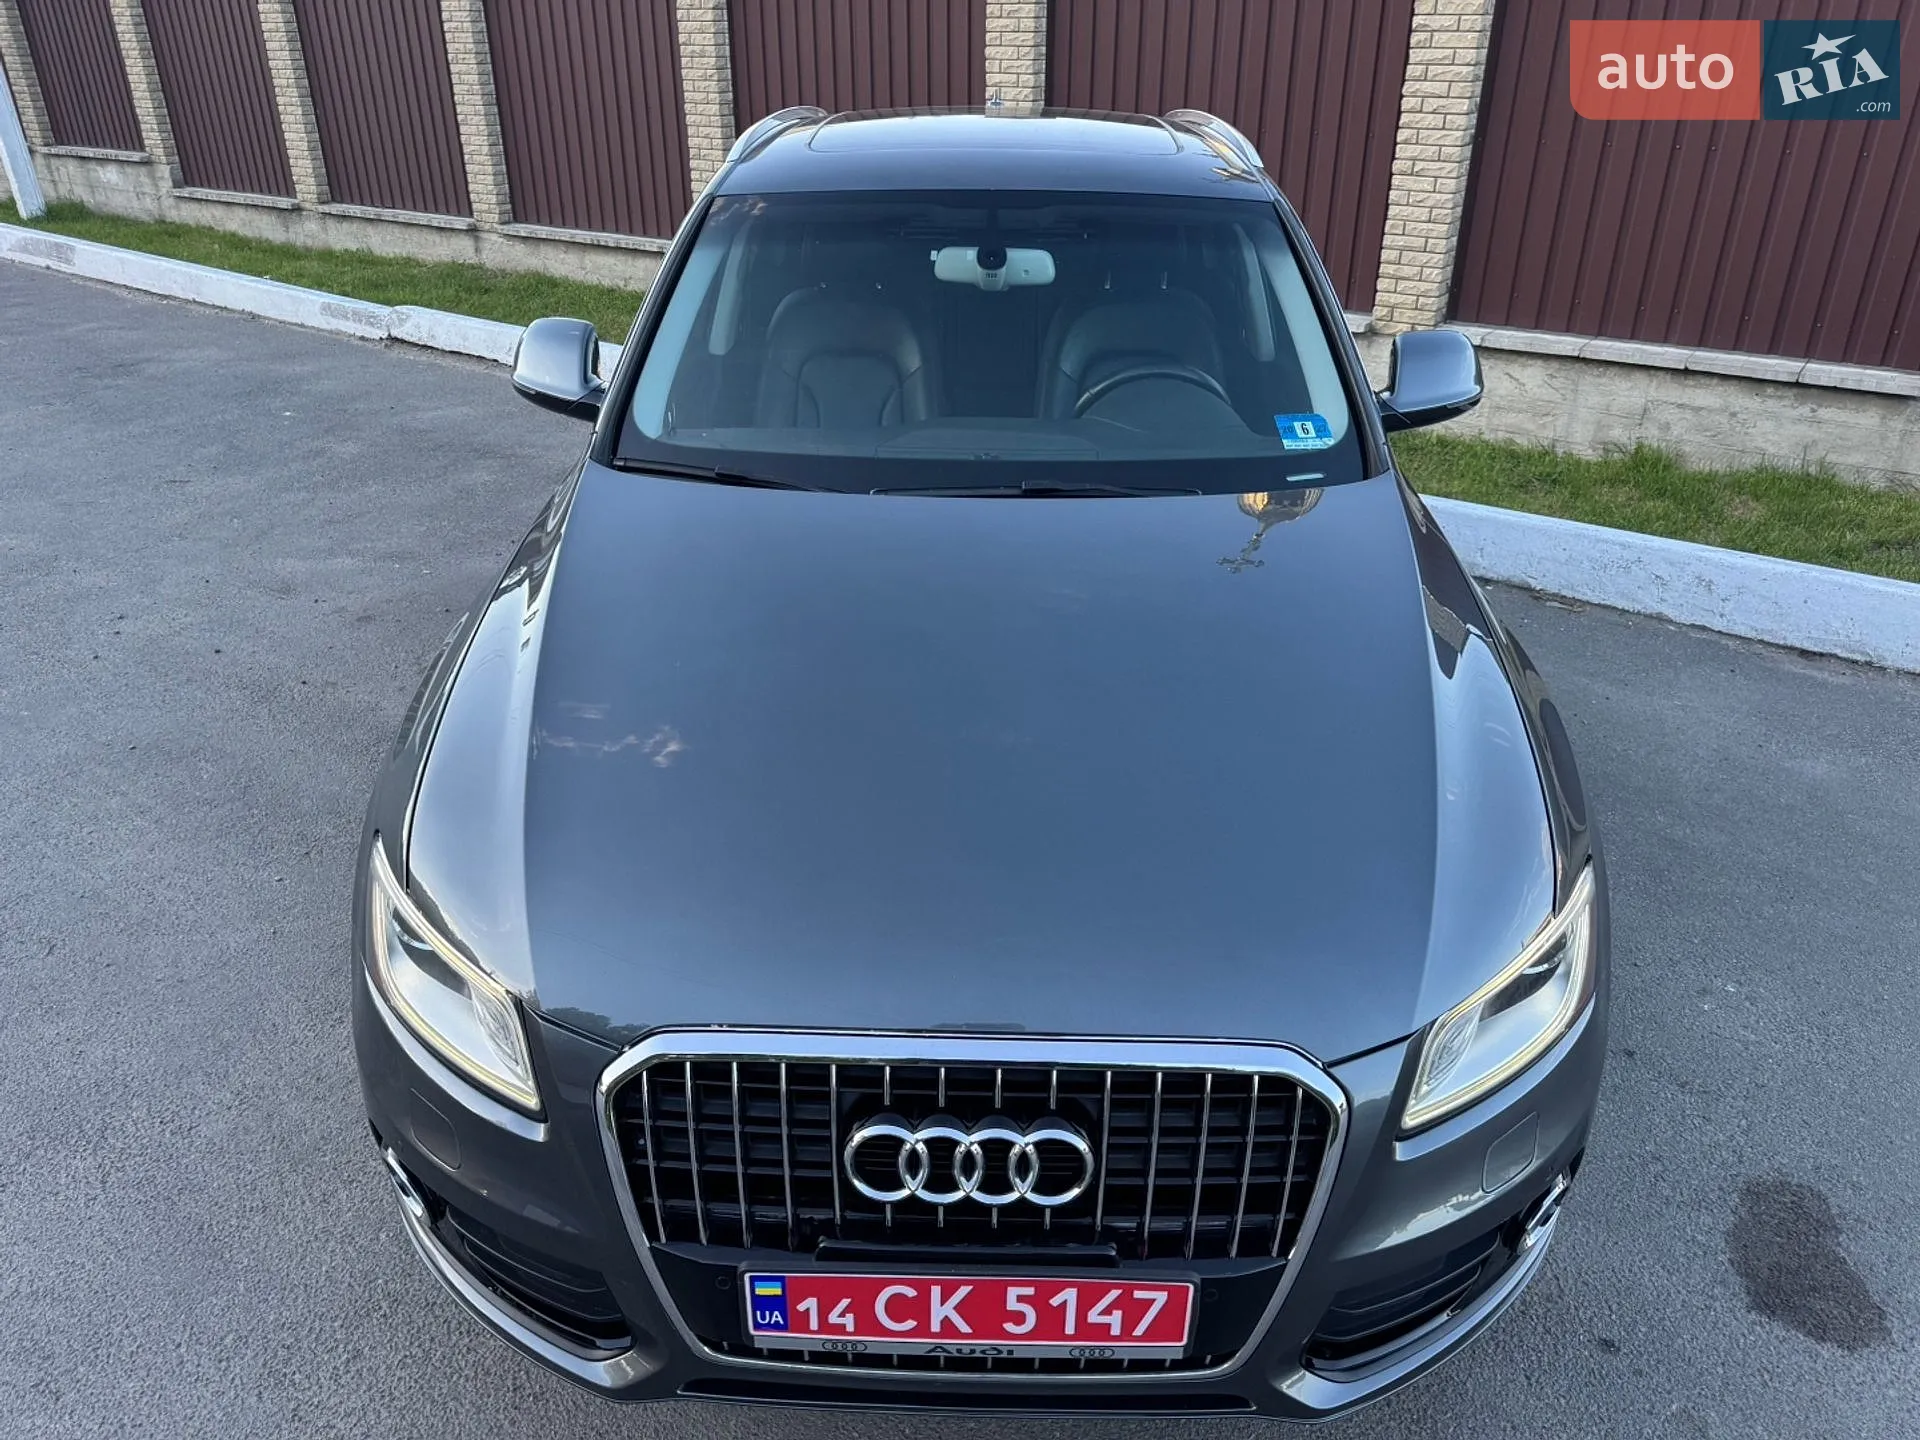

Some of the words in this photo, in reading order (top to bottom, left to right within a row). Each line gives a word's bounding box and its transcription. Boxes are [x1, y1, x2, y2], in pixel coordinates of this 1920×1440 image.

[1301, 422, 1310, 436] 6
[796, 1298, 855, 1332] 14
[874, 1285, 973, 1334] CK
[1002, 1286, 1168, 1337] 5147
[756, 1311, 784, 1326] UA
[924, 1345, 1014, 1356] Audi
